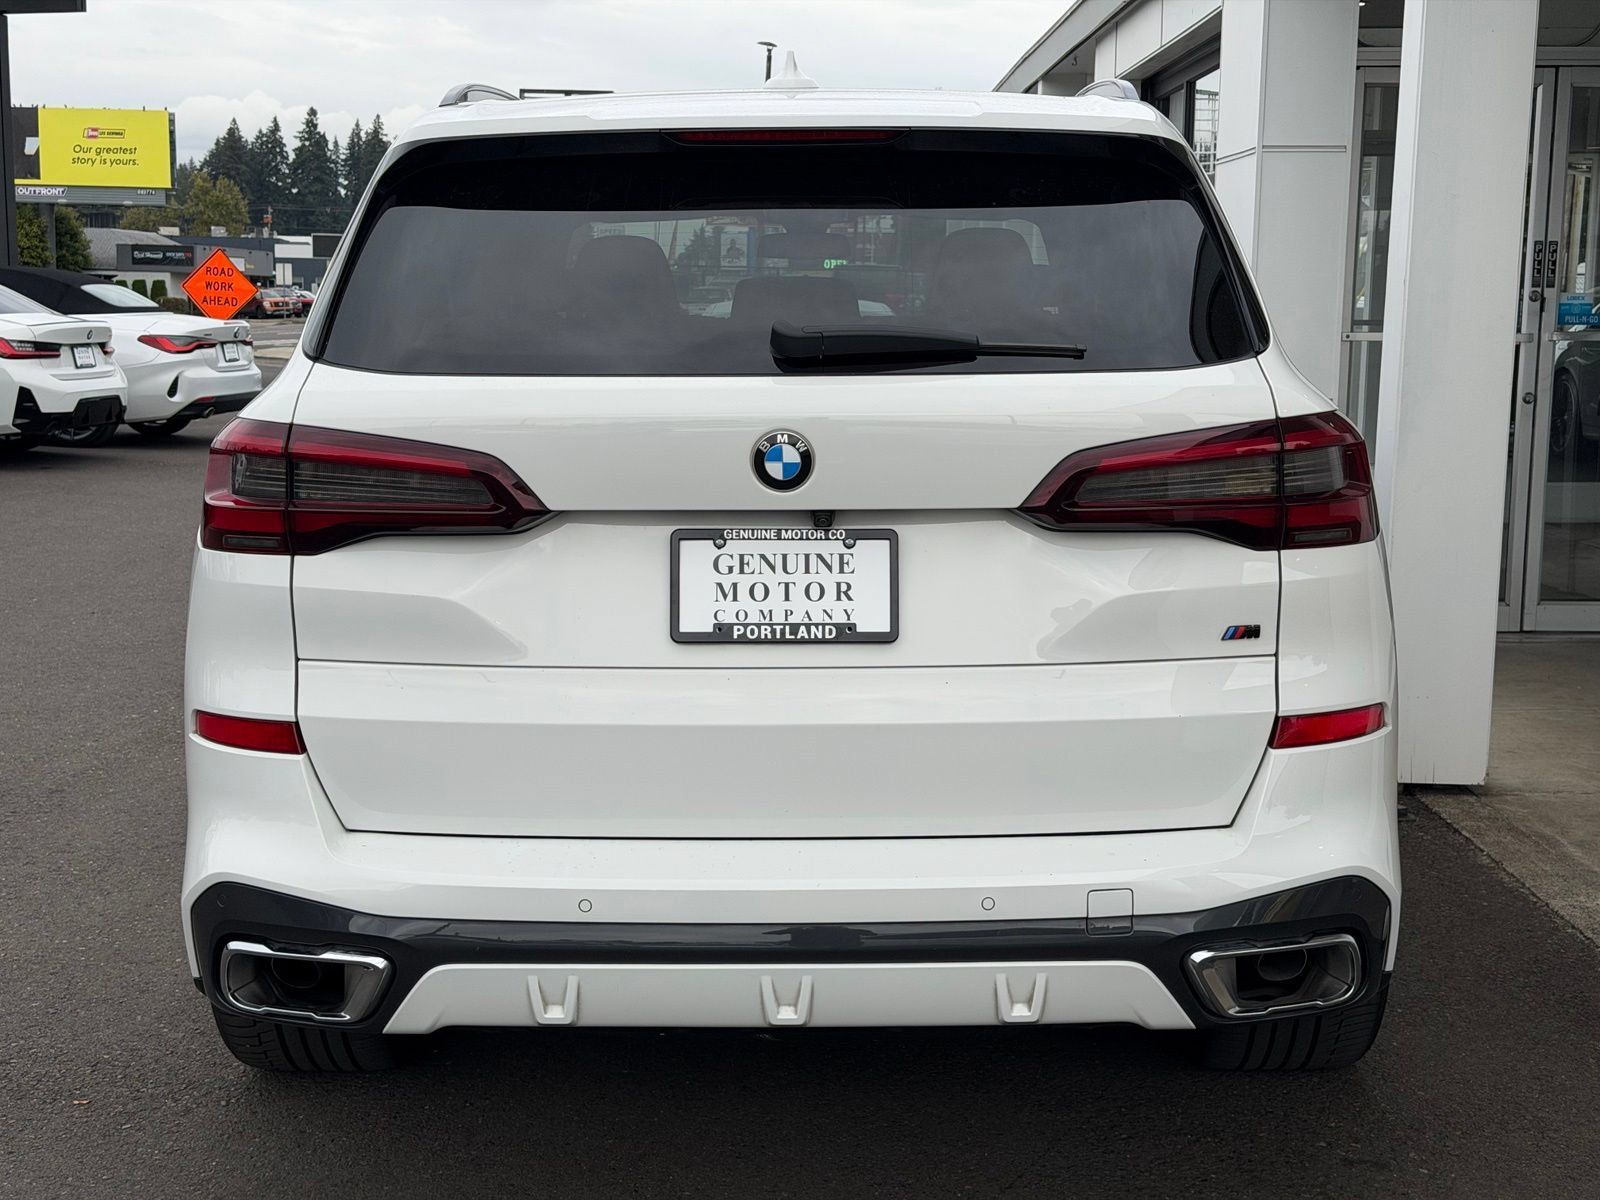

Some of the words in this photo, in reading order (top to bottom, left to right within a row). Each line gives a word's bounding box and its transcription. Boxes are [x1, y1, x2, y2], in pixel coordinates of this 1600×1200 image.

[73, 144, 92, 154] Our
[95, 145, 137, 156] greatest
[71, 155, 97, 167] story
[99, 155, 107, 165] is
[109, 157, 139, 168] yours.
[17, 187, 65, 196] OUTFRONT
[1534, 244, 1543, 277] PULL
[1548, 244, 1557, 277] PULL
[205, 267, 234, 277] ROAD
[205, 281, 234, 291] WORK
[201, 296, 238, 307] AHEAD
[759, 434, 807, 453] BMW
[723, 529, 778, 540] GENUINE
[781, 529, 825, 540] MOTOR
[828, 529, 846, 540] CO
[712, 553, 856, 575] GENUINE
[713, 581, 855, 602] MOTOR
[713, 609, 855, 622] COMPANY
[733, 625, 837, 639] PORTLAND
